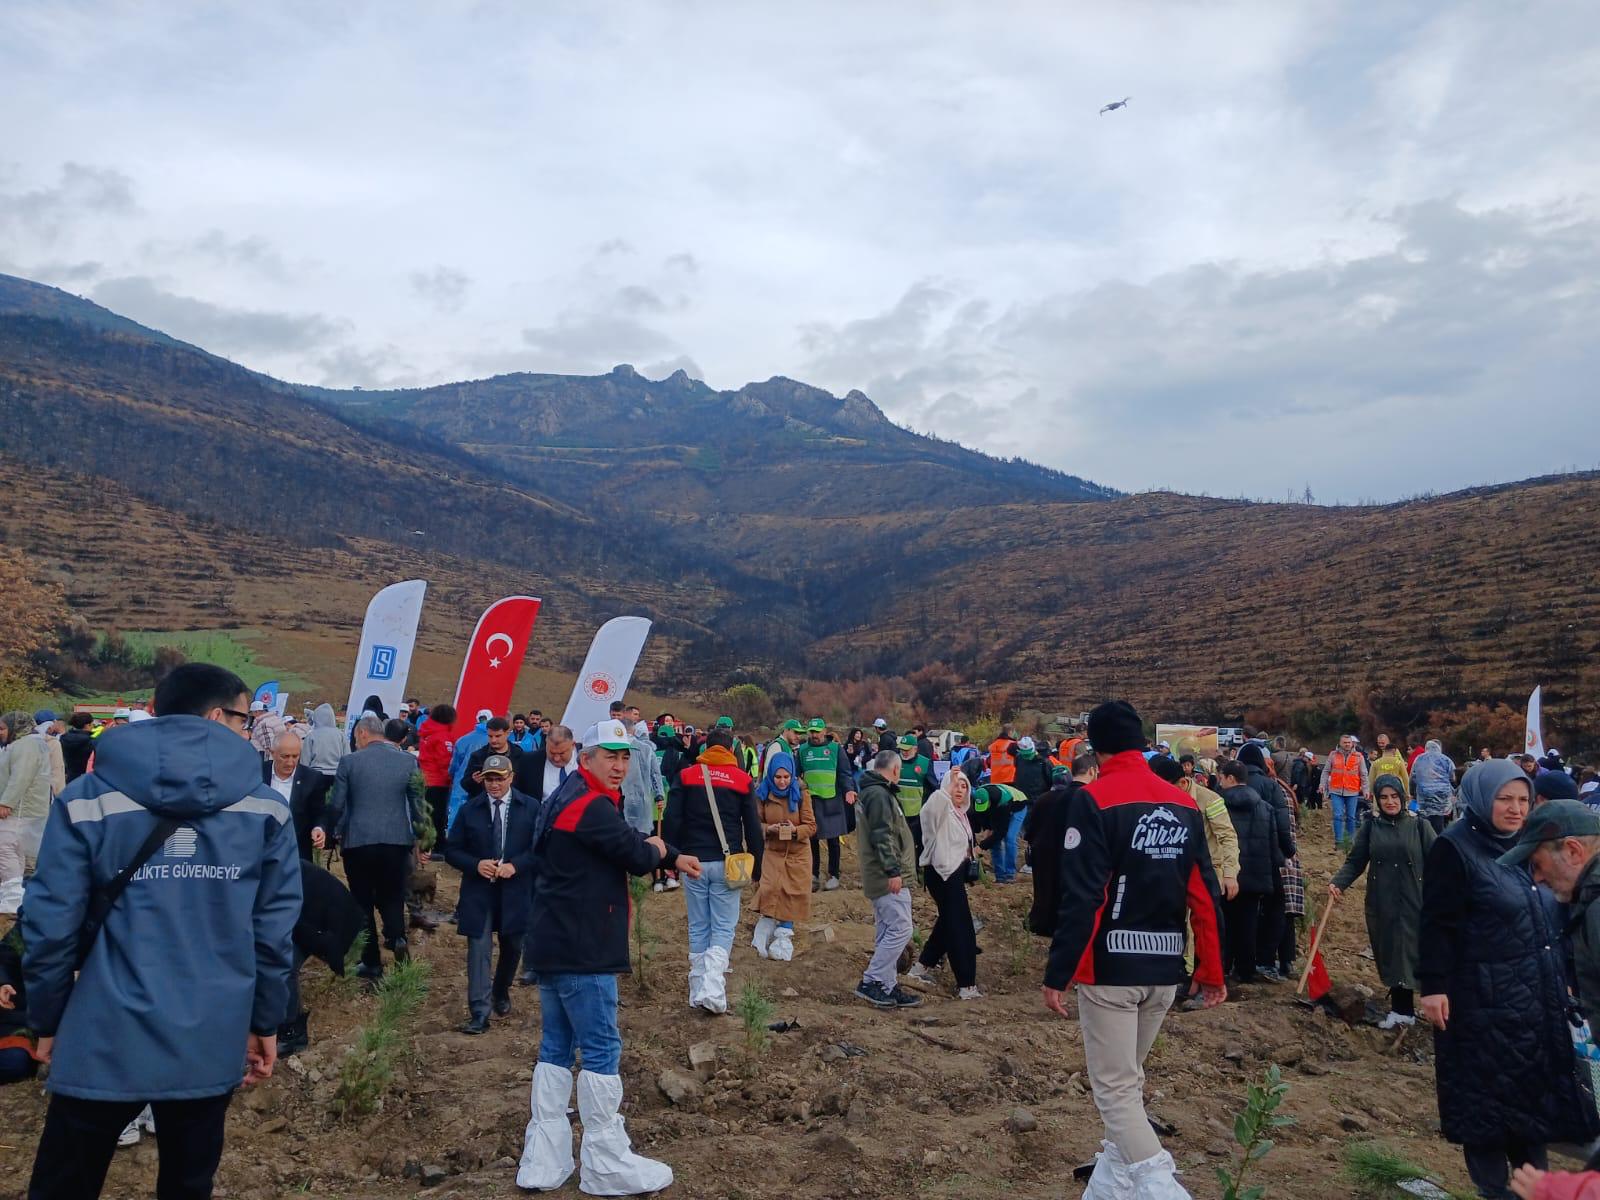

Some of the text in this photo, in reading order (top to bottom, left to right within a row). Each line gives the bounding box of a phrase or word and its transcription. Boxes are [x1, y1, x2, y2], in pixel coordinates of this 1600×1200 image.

[708, 769, 730, 780] URSA
[1131, 823, 1188, 851] Gürsu
[119, 862, 241, 881] LİKTE GÜVENDEYİZ
